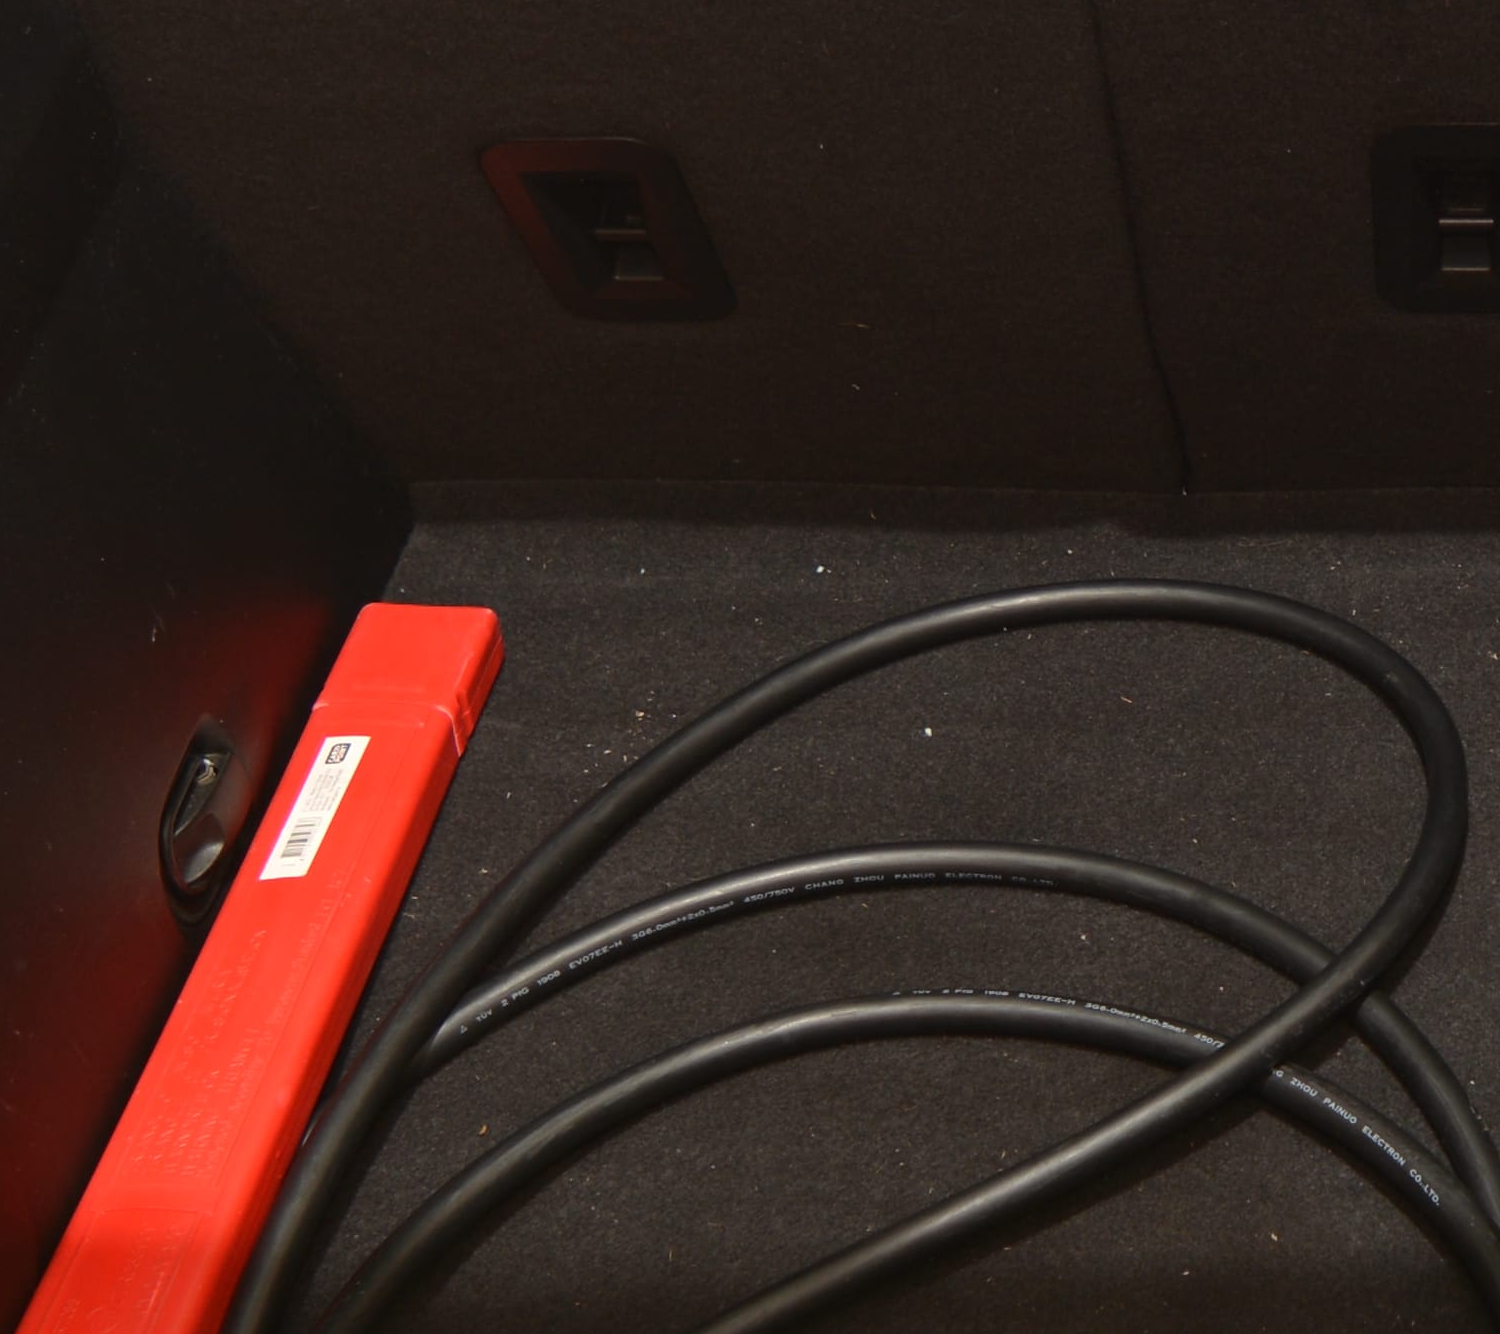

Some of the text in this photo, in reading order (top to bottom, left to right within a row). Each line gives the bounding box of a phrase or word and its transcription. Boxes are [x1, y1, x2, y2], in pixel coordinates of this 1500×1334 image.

[743, 886, 796, 903] 450/750V
[804, 878, 845, 890] CHANG
[852, 874, 885, 884] ZHOU
[1289, 1077, 1319, 1098] ZHOU
[1323, 1097, 1358, 1125] PAINUO
[1361, 1125, 1407, 1167] ELECTRON
